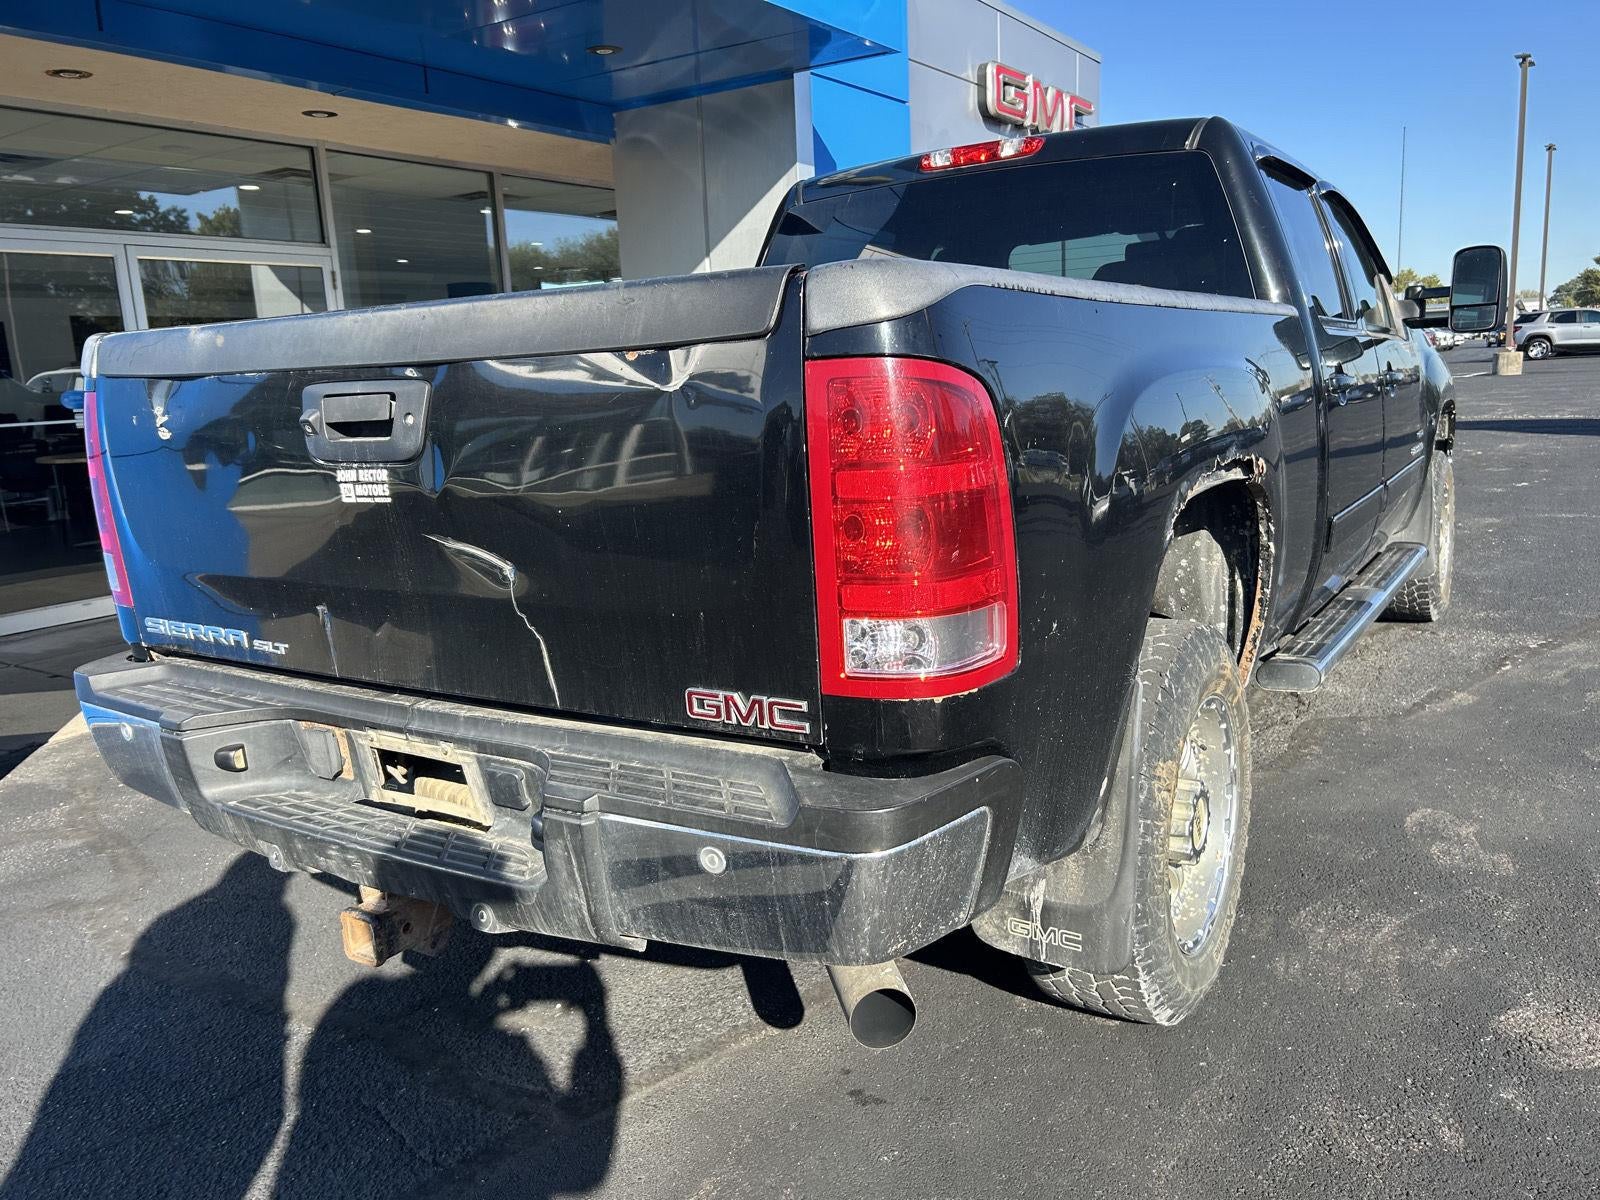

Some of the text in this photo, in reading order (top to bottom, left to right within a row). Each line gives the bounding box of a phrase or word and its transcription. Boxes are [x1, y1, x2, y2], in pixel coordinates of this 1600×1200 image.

[978, 61, 1094, 133] GMC
[336, 469, 388, 482] JOHN RECTOR
[355, 484, 390, 496] MOTORS
[144, 616, 289, 655] SIERRA SLT
[685, 687, 810, 734] GMC
[1007, 917, 1082, 952] GMC
